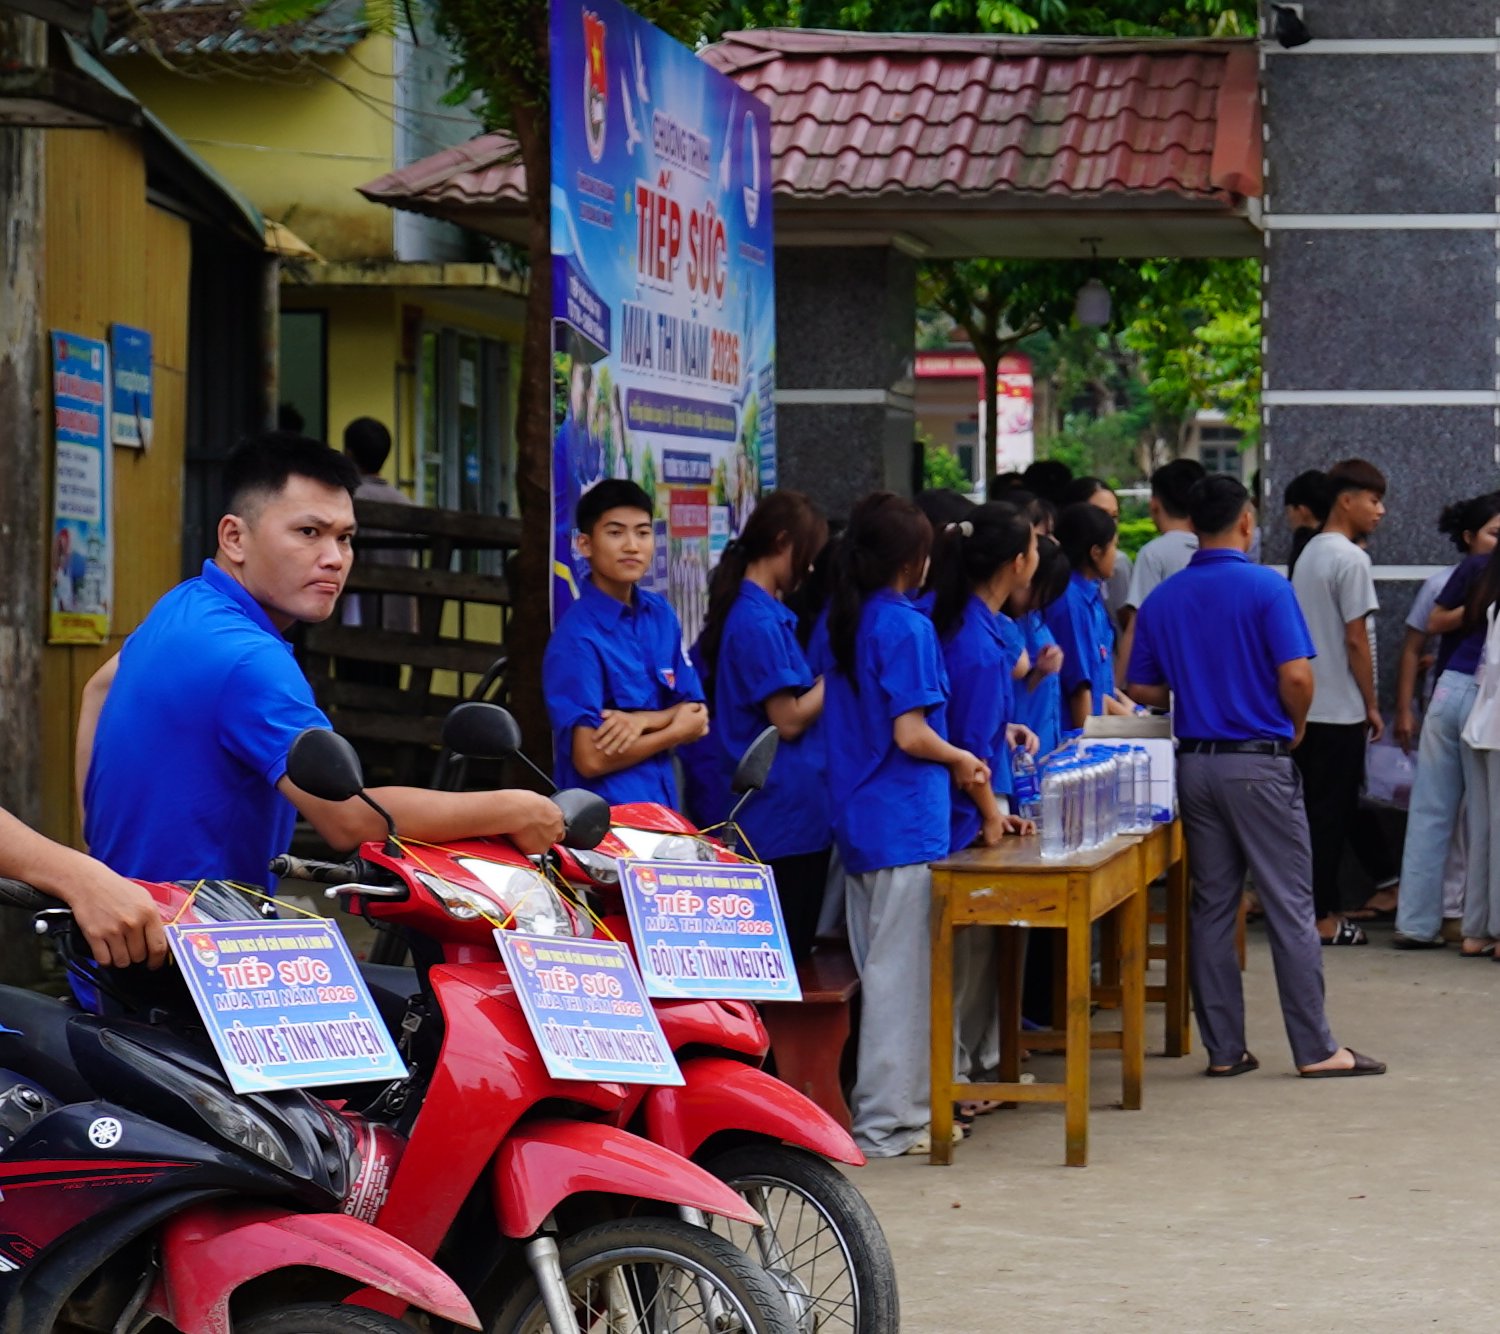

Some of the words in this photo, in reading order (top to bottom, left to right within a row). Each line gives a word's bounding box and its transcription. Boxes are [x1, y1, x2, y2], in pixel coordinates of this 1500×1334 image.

[635, 169, 683, 295] TIẾP
[687, 198, 729, 311] SỨC
[620, 283, 652, 371] MÙA
[656, 312, 680, 374] THI
[680, 307, 710, 380] NĂM
[710, 326, 741, 388] 2026
[213, 988, 252, 1012] MÙA
[253, 989, 280, 1008] THI
[280, 983, 317, 1006] NĂM
[317, 985, 358, 1005] 2026
[216, 956, 274, 990] TIẾP
[277, 955, 332, 986] SỨC
[224, 1020, 265, 1073] ĐỘI
[253, 1025, 288, 1066] XE
[273, 1016, 327, 1065] TÌNH
[313, 1011, 389, 1066] NGUYỆN
